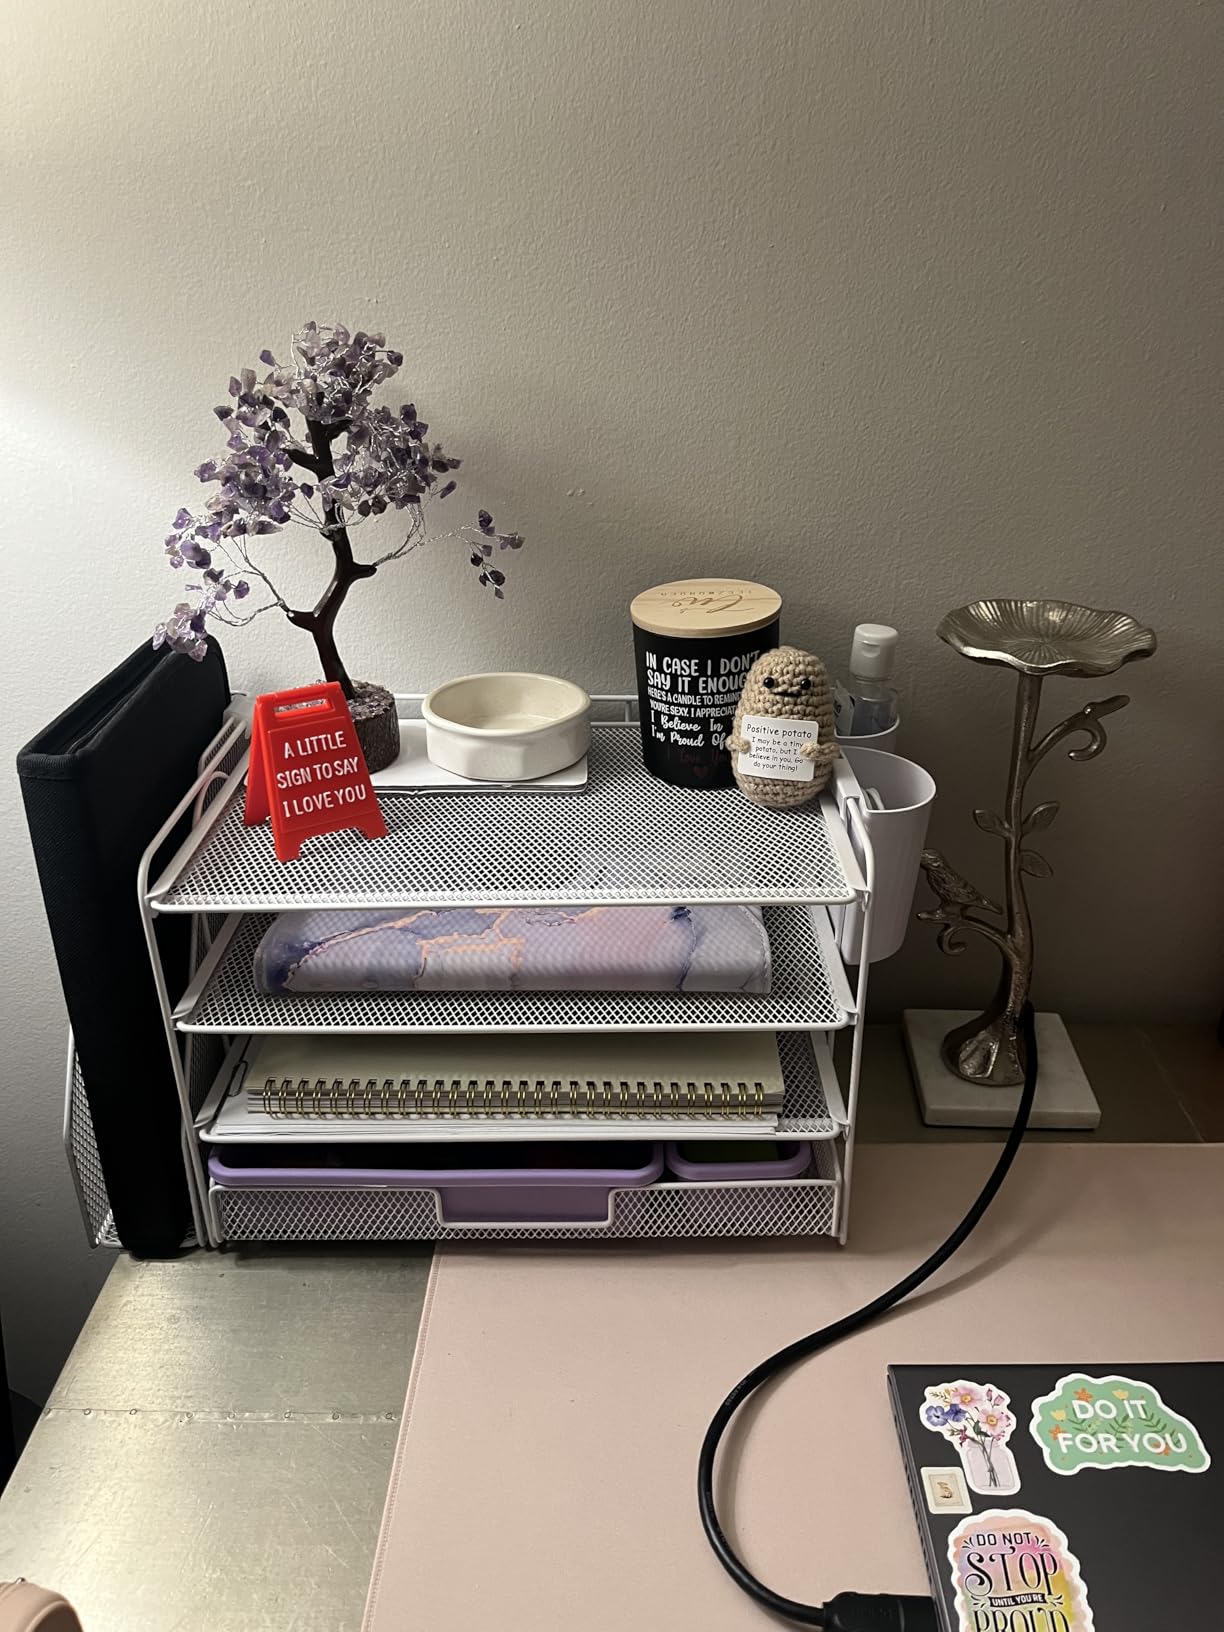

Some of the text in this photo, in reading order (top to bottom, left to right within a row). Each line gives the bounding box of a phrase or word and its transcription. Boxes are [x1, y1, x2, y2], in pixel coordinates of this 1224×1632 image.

[646, 650, 760, 676] IN CASE I DON'T
[647, 669, 746, 693] SAY IT ENOUG
[648, 687, 666, 702] HERE'S
[667, 694, 672, 702] A
[673, 694, 702, 705] CANDLE
[702, 696, 713, 705] TO
[650, 699, 736, 717] YOU'RE SEXY. I APPRECIAT
[651, 710, 723, 732] I Believe In
[747, 724, 812, 738] Positive potato
[284, 731, 346, 759] A LITTLE
[651, 725, 726, 750] I'm Proud Of
[790, 740, 803, 748] tiny
[277, 757, 359, 789] SIGN TO SAY
[779, 763, 797, 772] thing!
[283, 784, 366, 818] I LOVE YOU
[1071, 1399, 1146, 1420] DO IT
[1057, 1433, 1187, 1454] FOR YOU
[977, 1533, 1031, 1546] DO NOT
[965, 1546, 1058, 1596] STOP
[992, 1594, 1044, 1606] UNTIL YOU'RE
